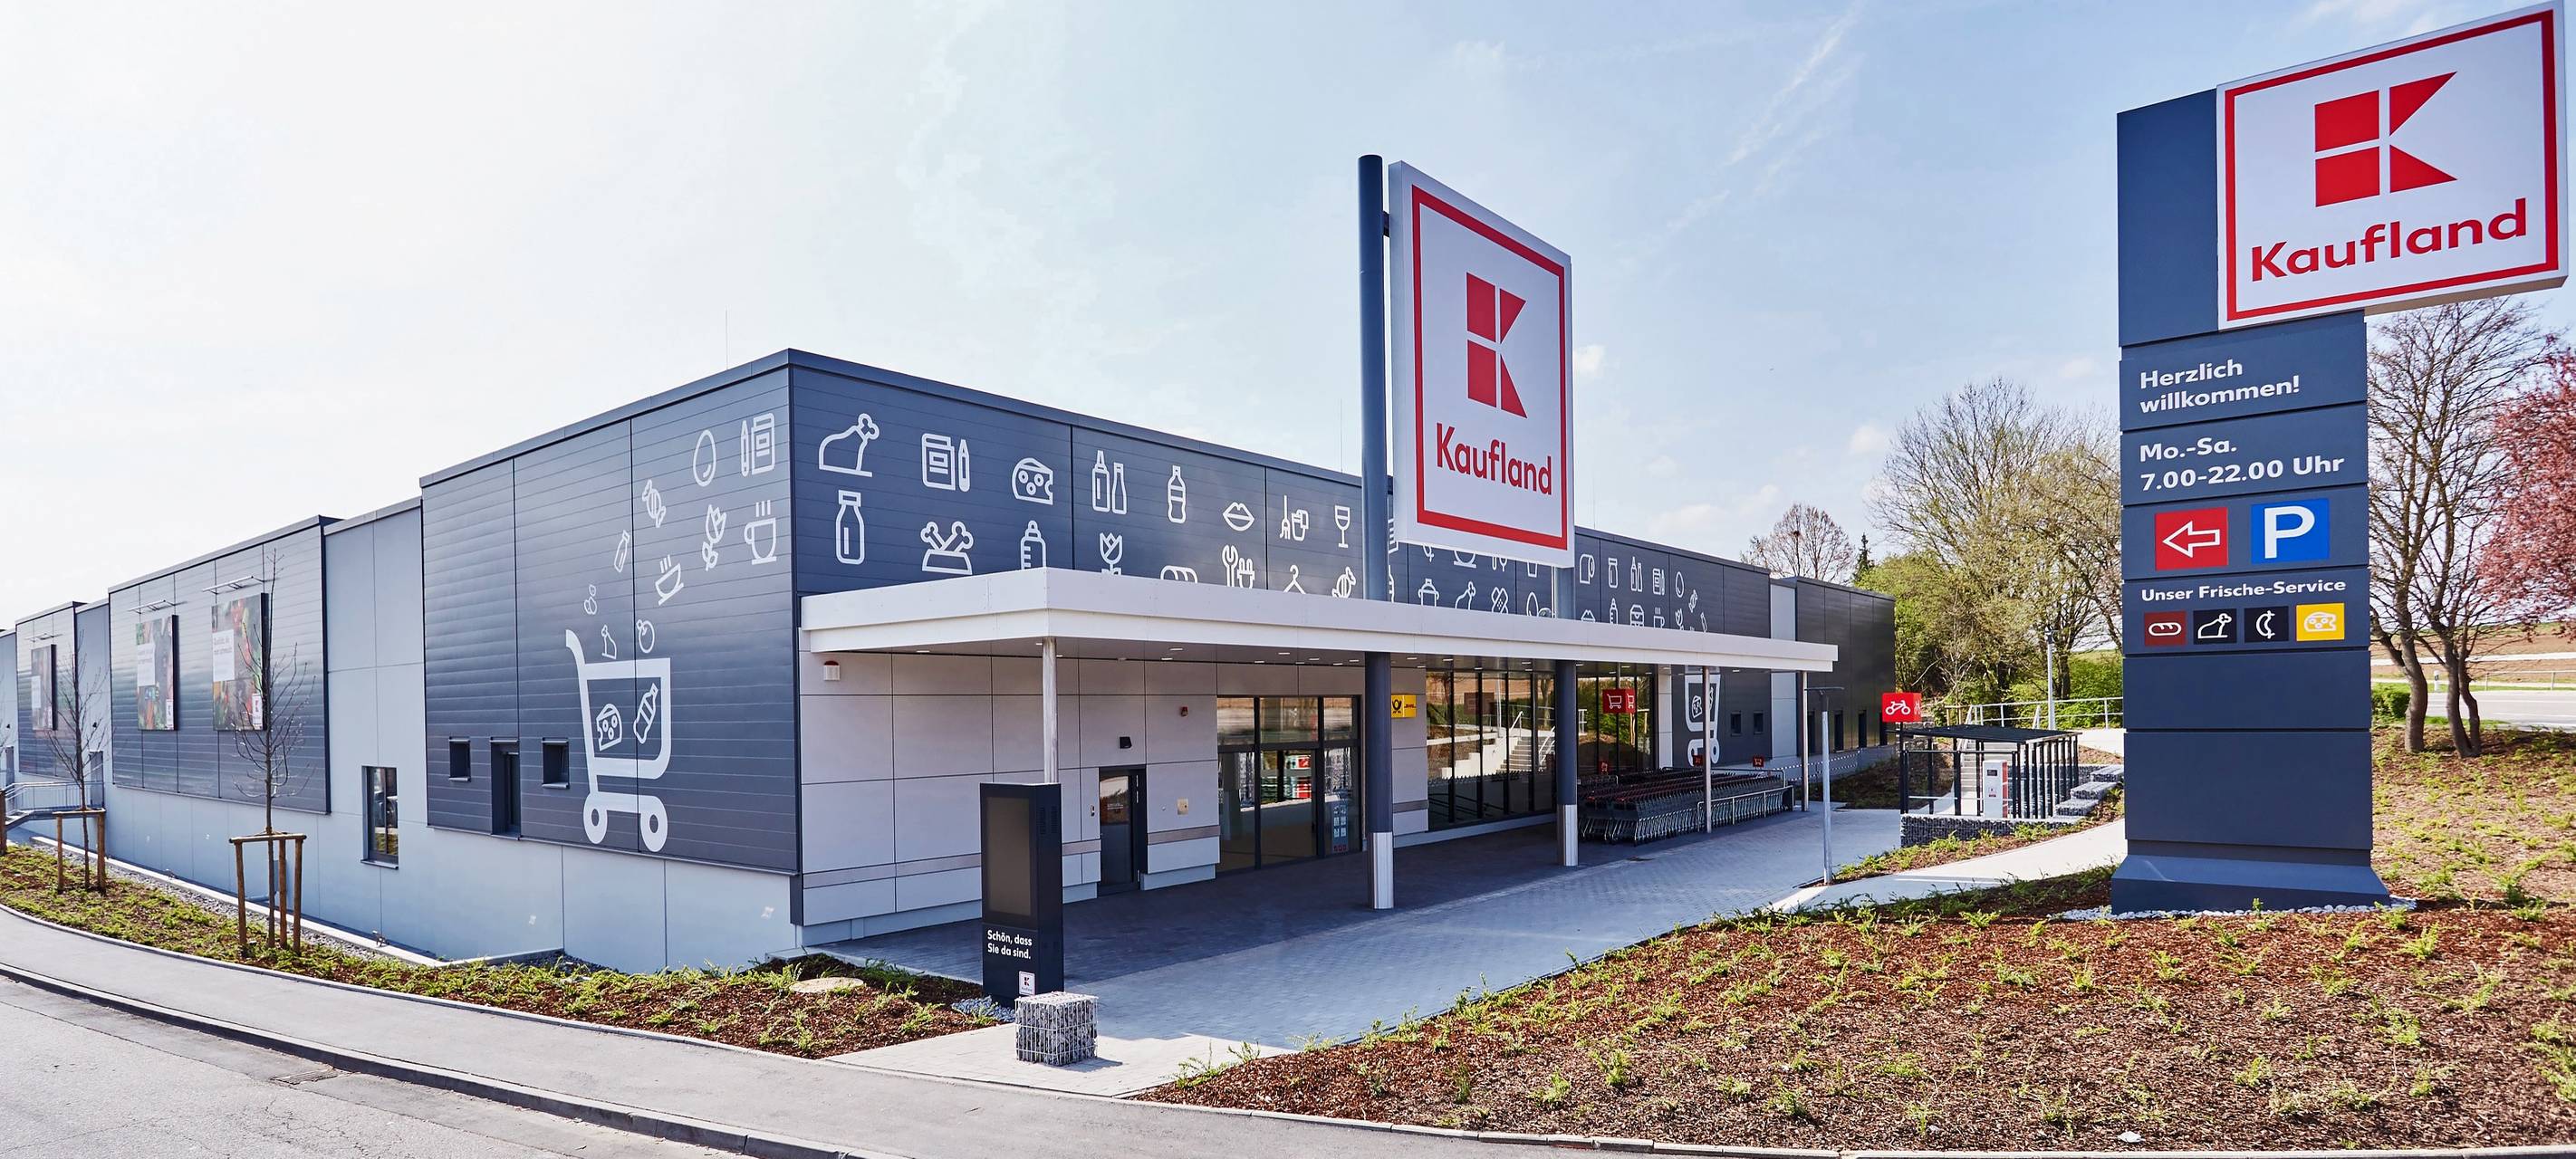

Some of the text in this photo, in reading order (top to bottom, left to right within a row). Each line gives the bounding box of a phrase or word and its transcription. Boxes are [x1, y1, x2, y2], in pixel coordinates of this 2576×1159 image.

[2314, 71, 2457, 207] K
[2252, 197, 2526, 283] Kaufland
[1466, 272, 1527, 418] K
[2140, 359, 2243, 389] Herzlich
[2139, 375, 2301, 414] willkommen!
[1436, 422, 1552, 495] Kaufland
[2139, 436, 2237, 462] Mo.-Sa.
[2140, 455, 2345, 492] 7.00-22.00 Uhr
[2264, 505, 2315, 560] P
[2141, 580, 2346, 601] Unser Frische-Service
[987, 929, 1033, 946] Schön, dass
[987, 943, 1032, 960] Sie da sind.
